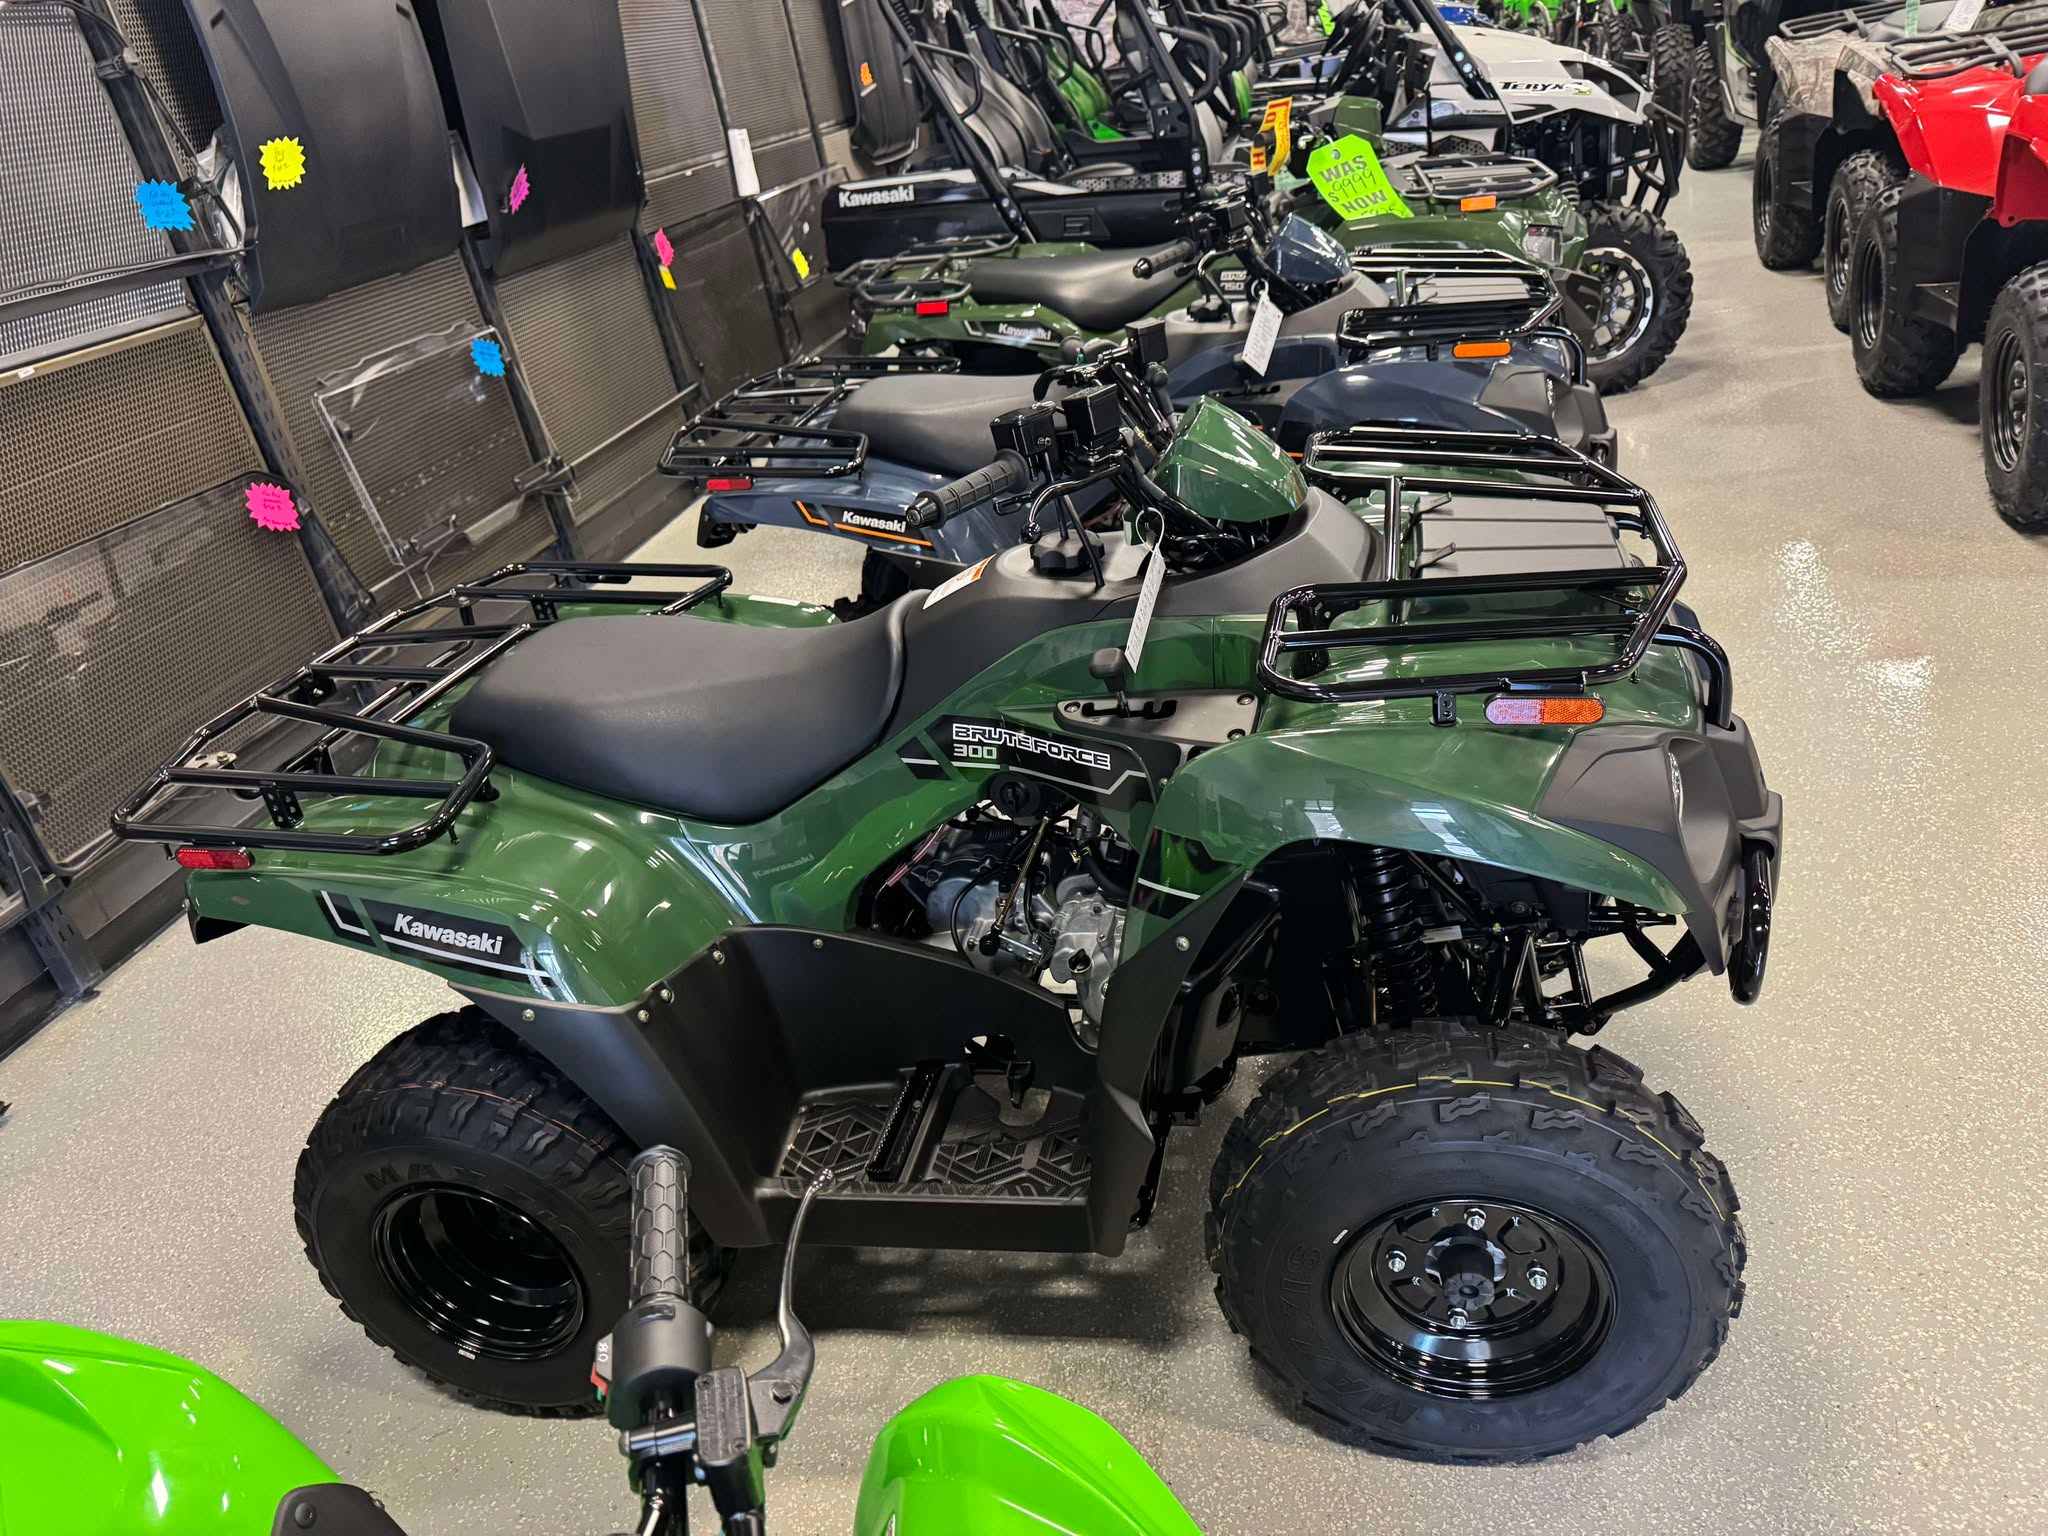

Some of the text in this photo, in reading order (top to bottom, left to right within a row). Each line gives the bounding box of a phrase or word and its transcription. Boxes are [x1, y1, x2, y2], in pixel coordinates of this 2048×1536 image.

[1319, 155, 1368, 183] WAS
[838, 184, 914, 208] Kawasaki
[1327, 168, 1377, 203] $9999
[1341, 190, 1387, 213] NOW
[841, 510, 907, 533] Kawasaki
[953, 743, 998, 760] 300
[394, 913, 503, 955] Kawasaki
